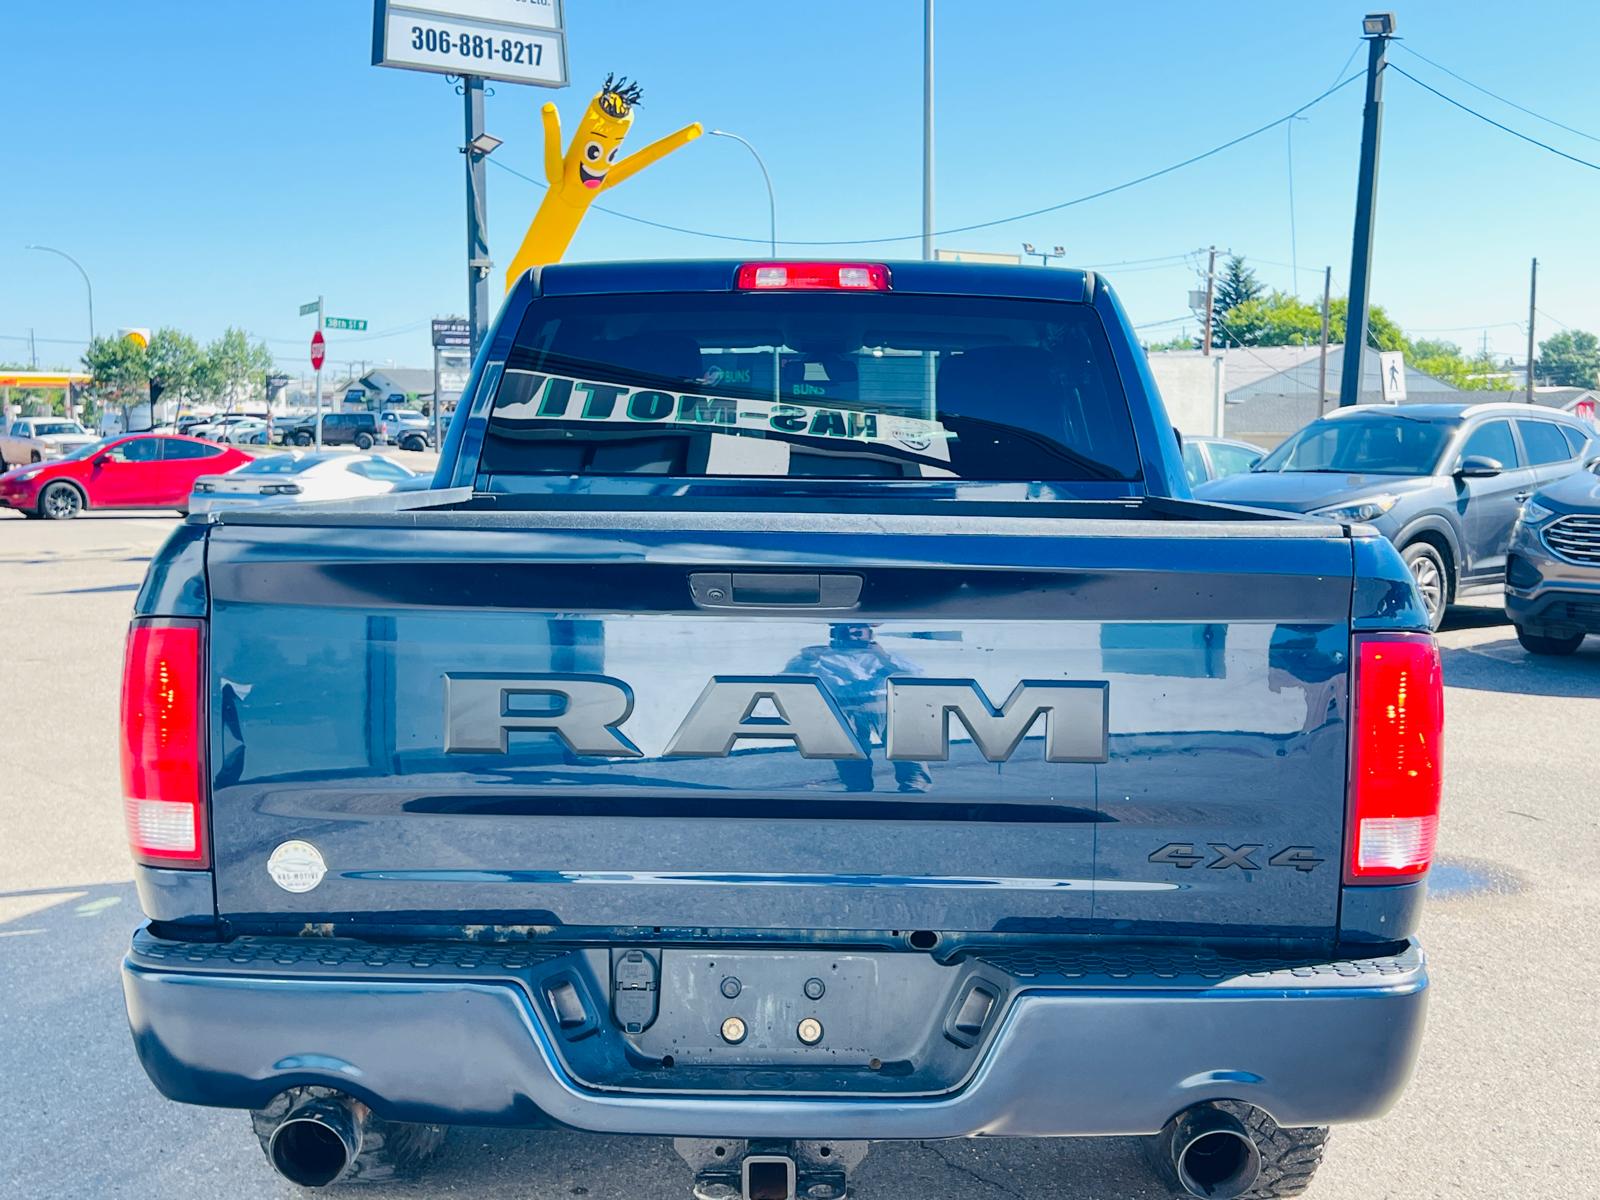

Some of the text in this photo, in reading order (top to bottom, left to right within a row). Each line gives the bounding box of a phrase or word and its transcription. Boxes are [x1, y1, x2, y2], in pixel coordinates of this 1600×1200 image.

[411, 26, 543, 67] 306-881-8217
[443, 672, 1110, 764] RAM
[1147, 842, 1326, 872] 4X4
